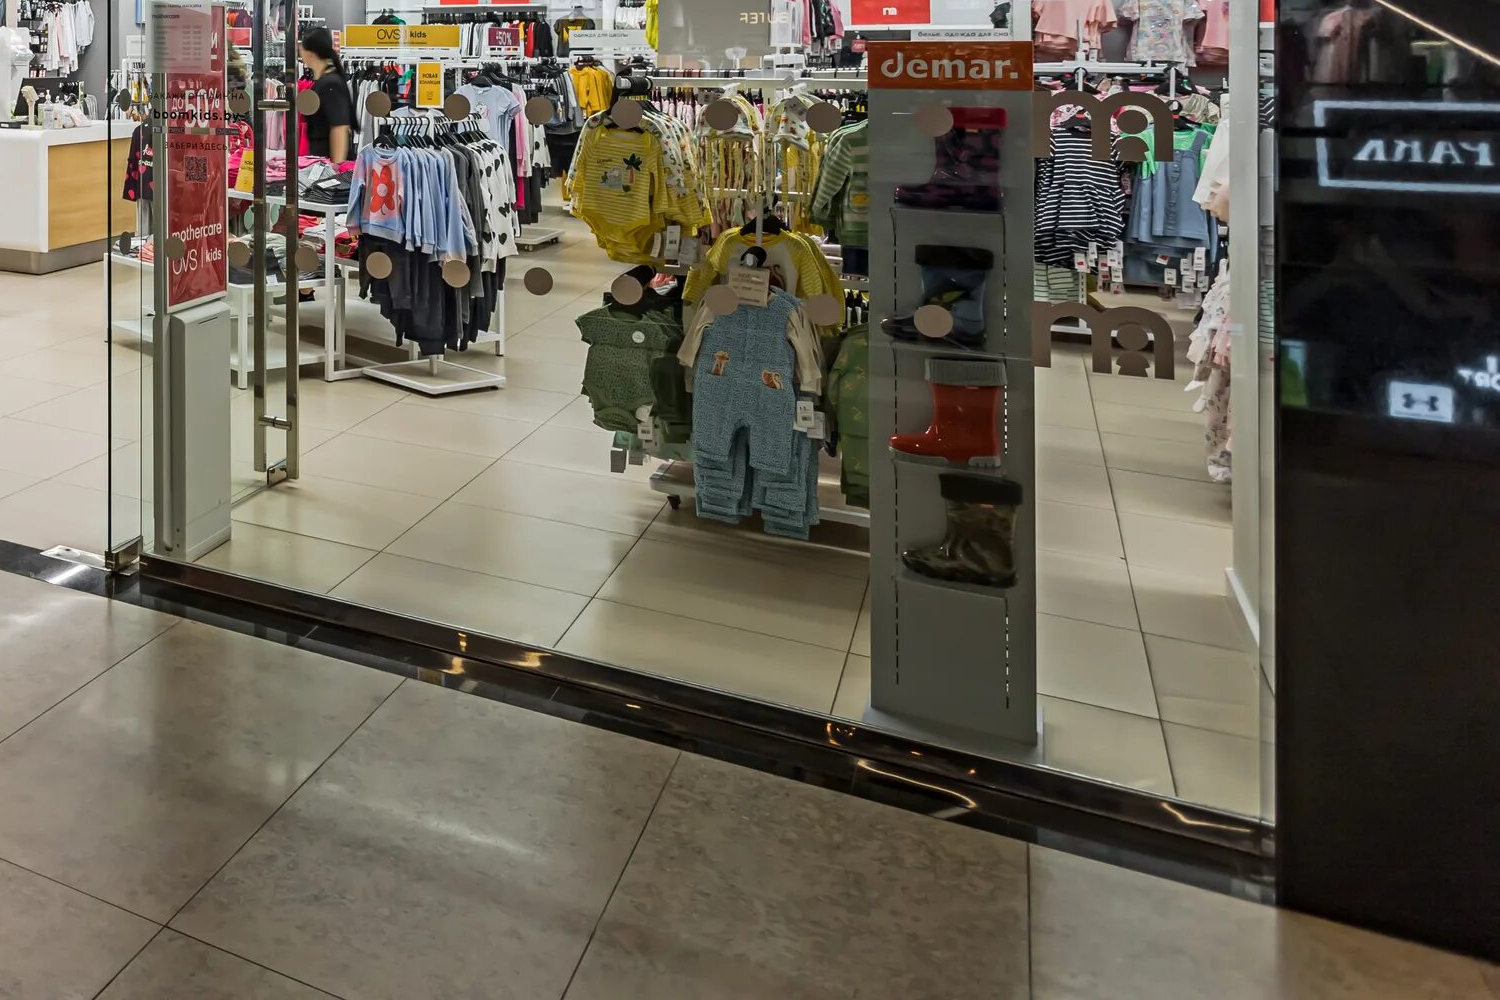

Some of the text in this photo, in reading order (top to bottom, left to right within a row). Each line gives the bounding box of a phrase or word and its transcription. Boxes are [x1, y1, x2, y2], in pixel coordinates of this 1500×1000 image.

[376, 28, 427, 41] OVS kids
[231, 92, 245, 100] НА
[153, 109, 240, 123] boomkids.by
[205, 247, 222, 262] kids
